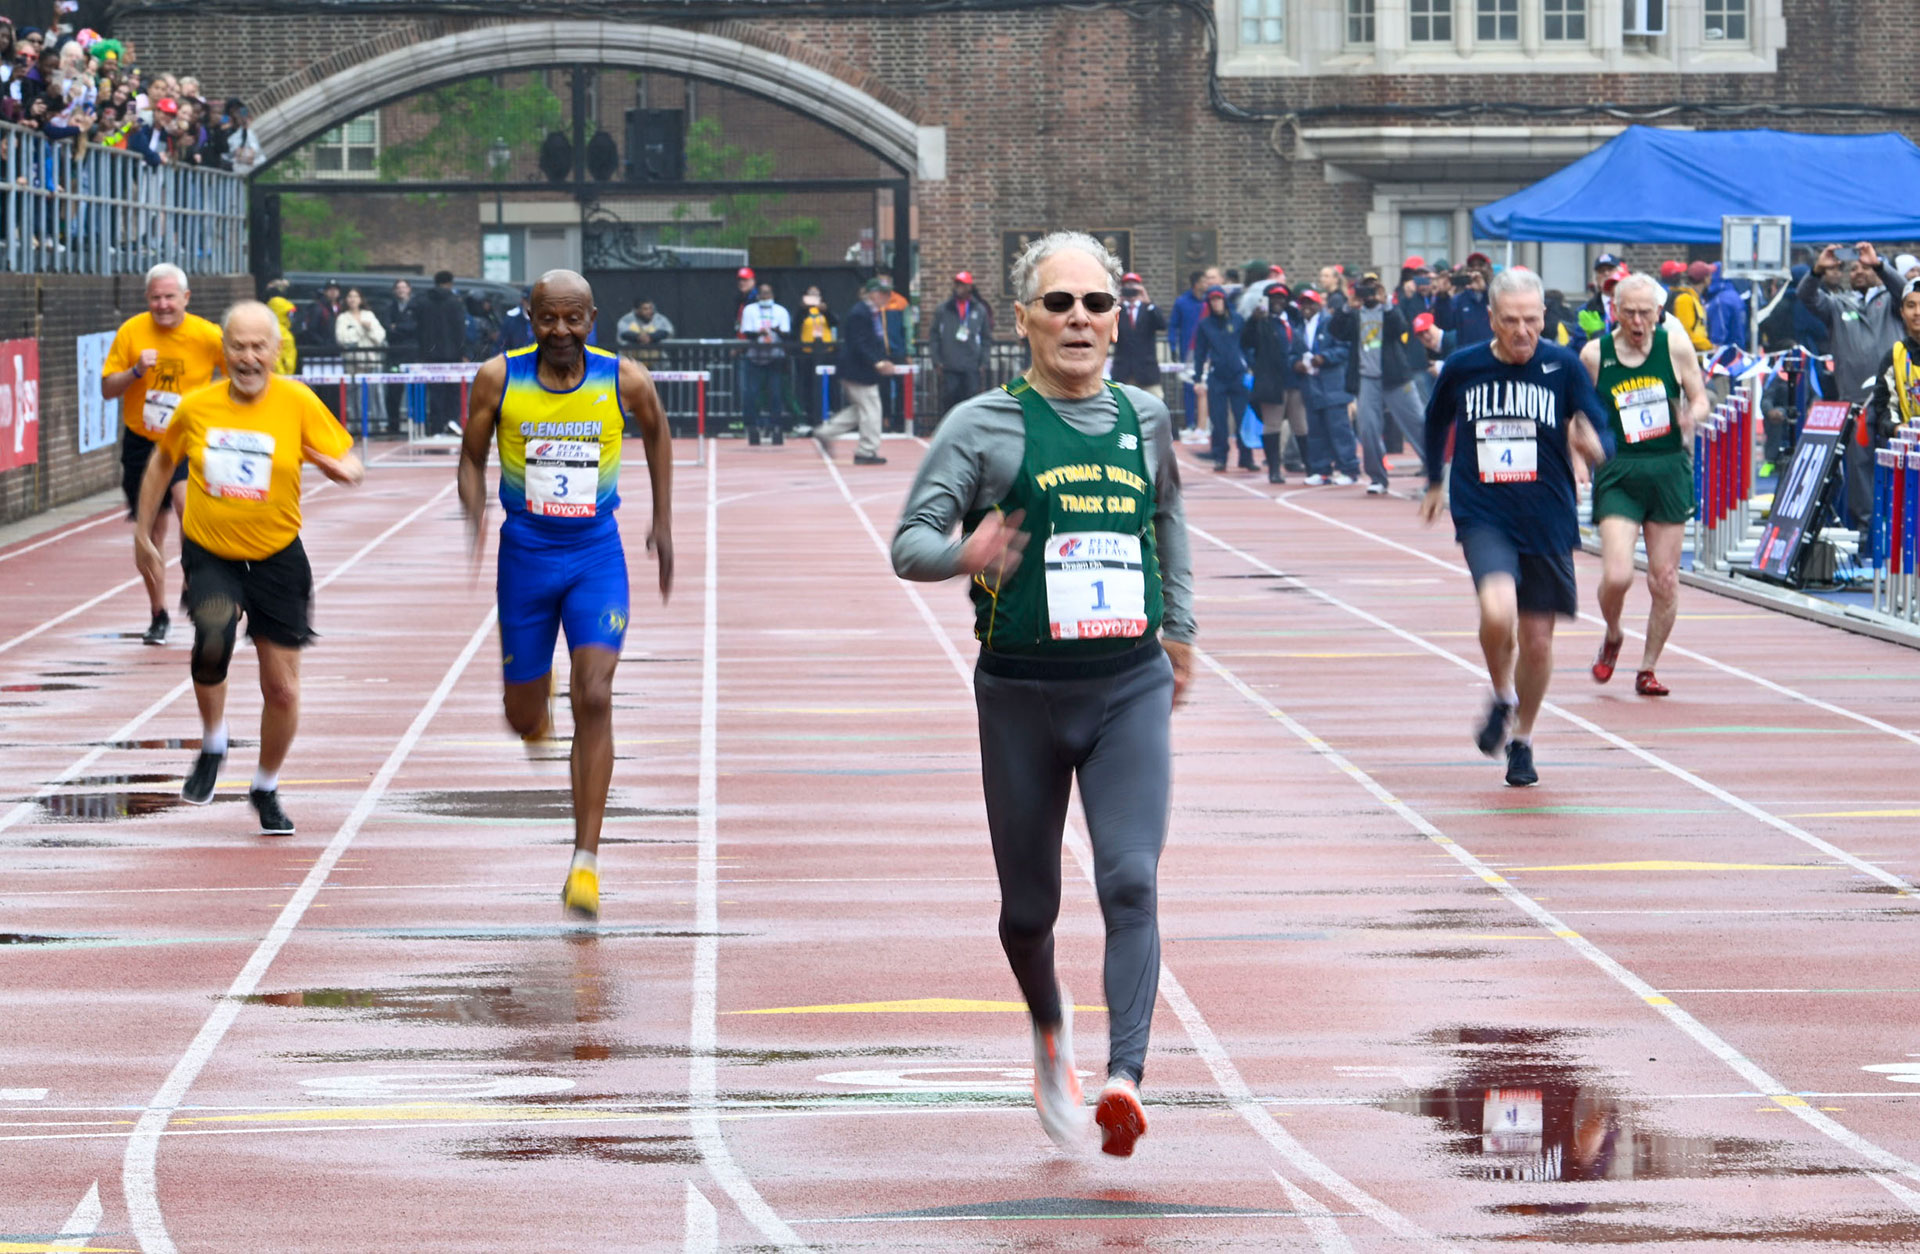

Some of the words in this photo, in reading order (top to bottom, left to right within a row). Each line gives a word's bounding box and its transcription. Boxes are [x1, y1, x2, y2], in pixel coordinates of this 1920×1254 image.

[1465, 380, 1556, 429] VILLANOVA
[159, 411, 167, 424] 7
[1640, 408, 1653, 427] 6
[520, 421, 602, 436] GLENARDEN
[1500, 448, 1513, 467] 4
[553, 474, 569, 498] 3
[1034, 463, 1103, 492] POTOMAC
[1495, 472, 1532, 482] TOYOTA
[546, 504, 590, 515] TOYOTA
[1058, 494, 1104, 513] TRACK
[1106, 496, 1136, 514] CLUB
[1089, 538, 1120, 546] PENN
[1091, 580, 1111, 611] 1
[1081, 621, 1139, 636] TOYOTA
